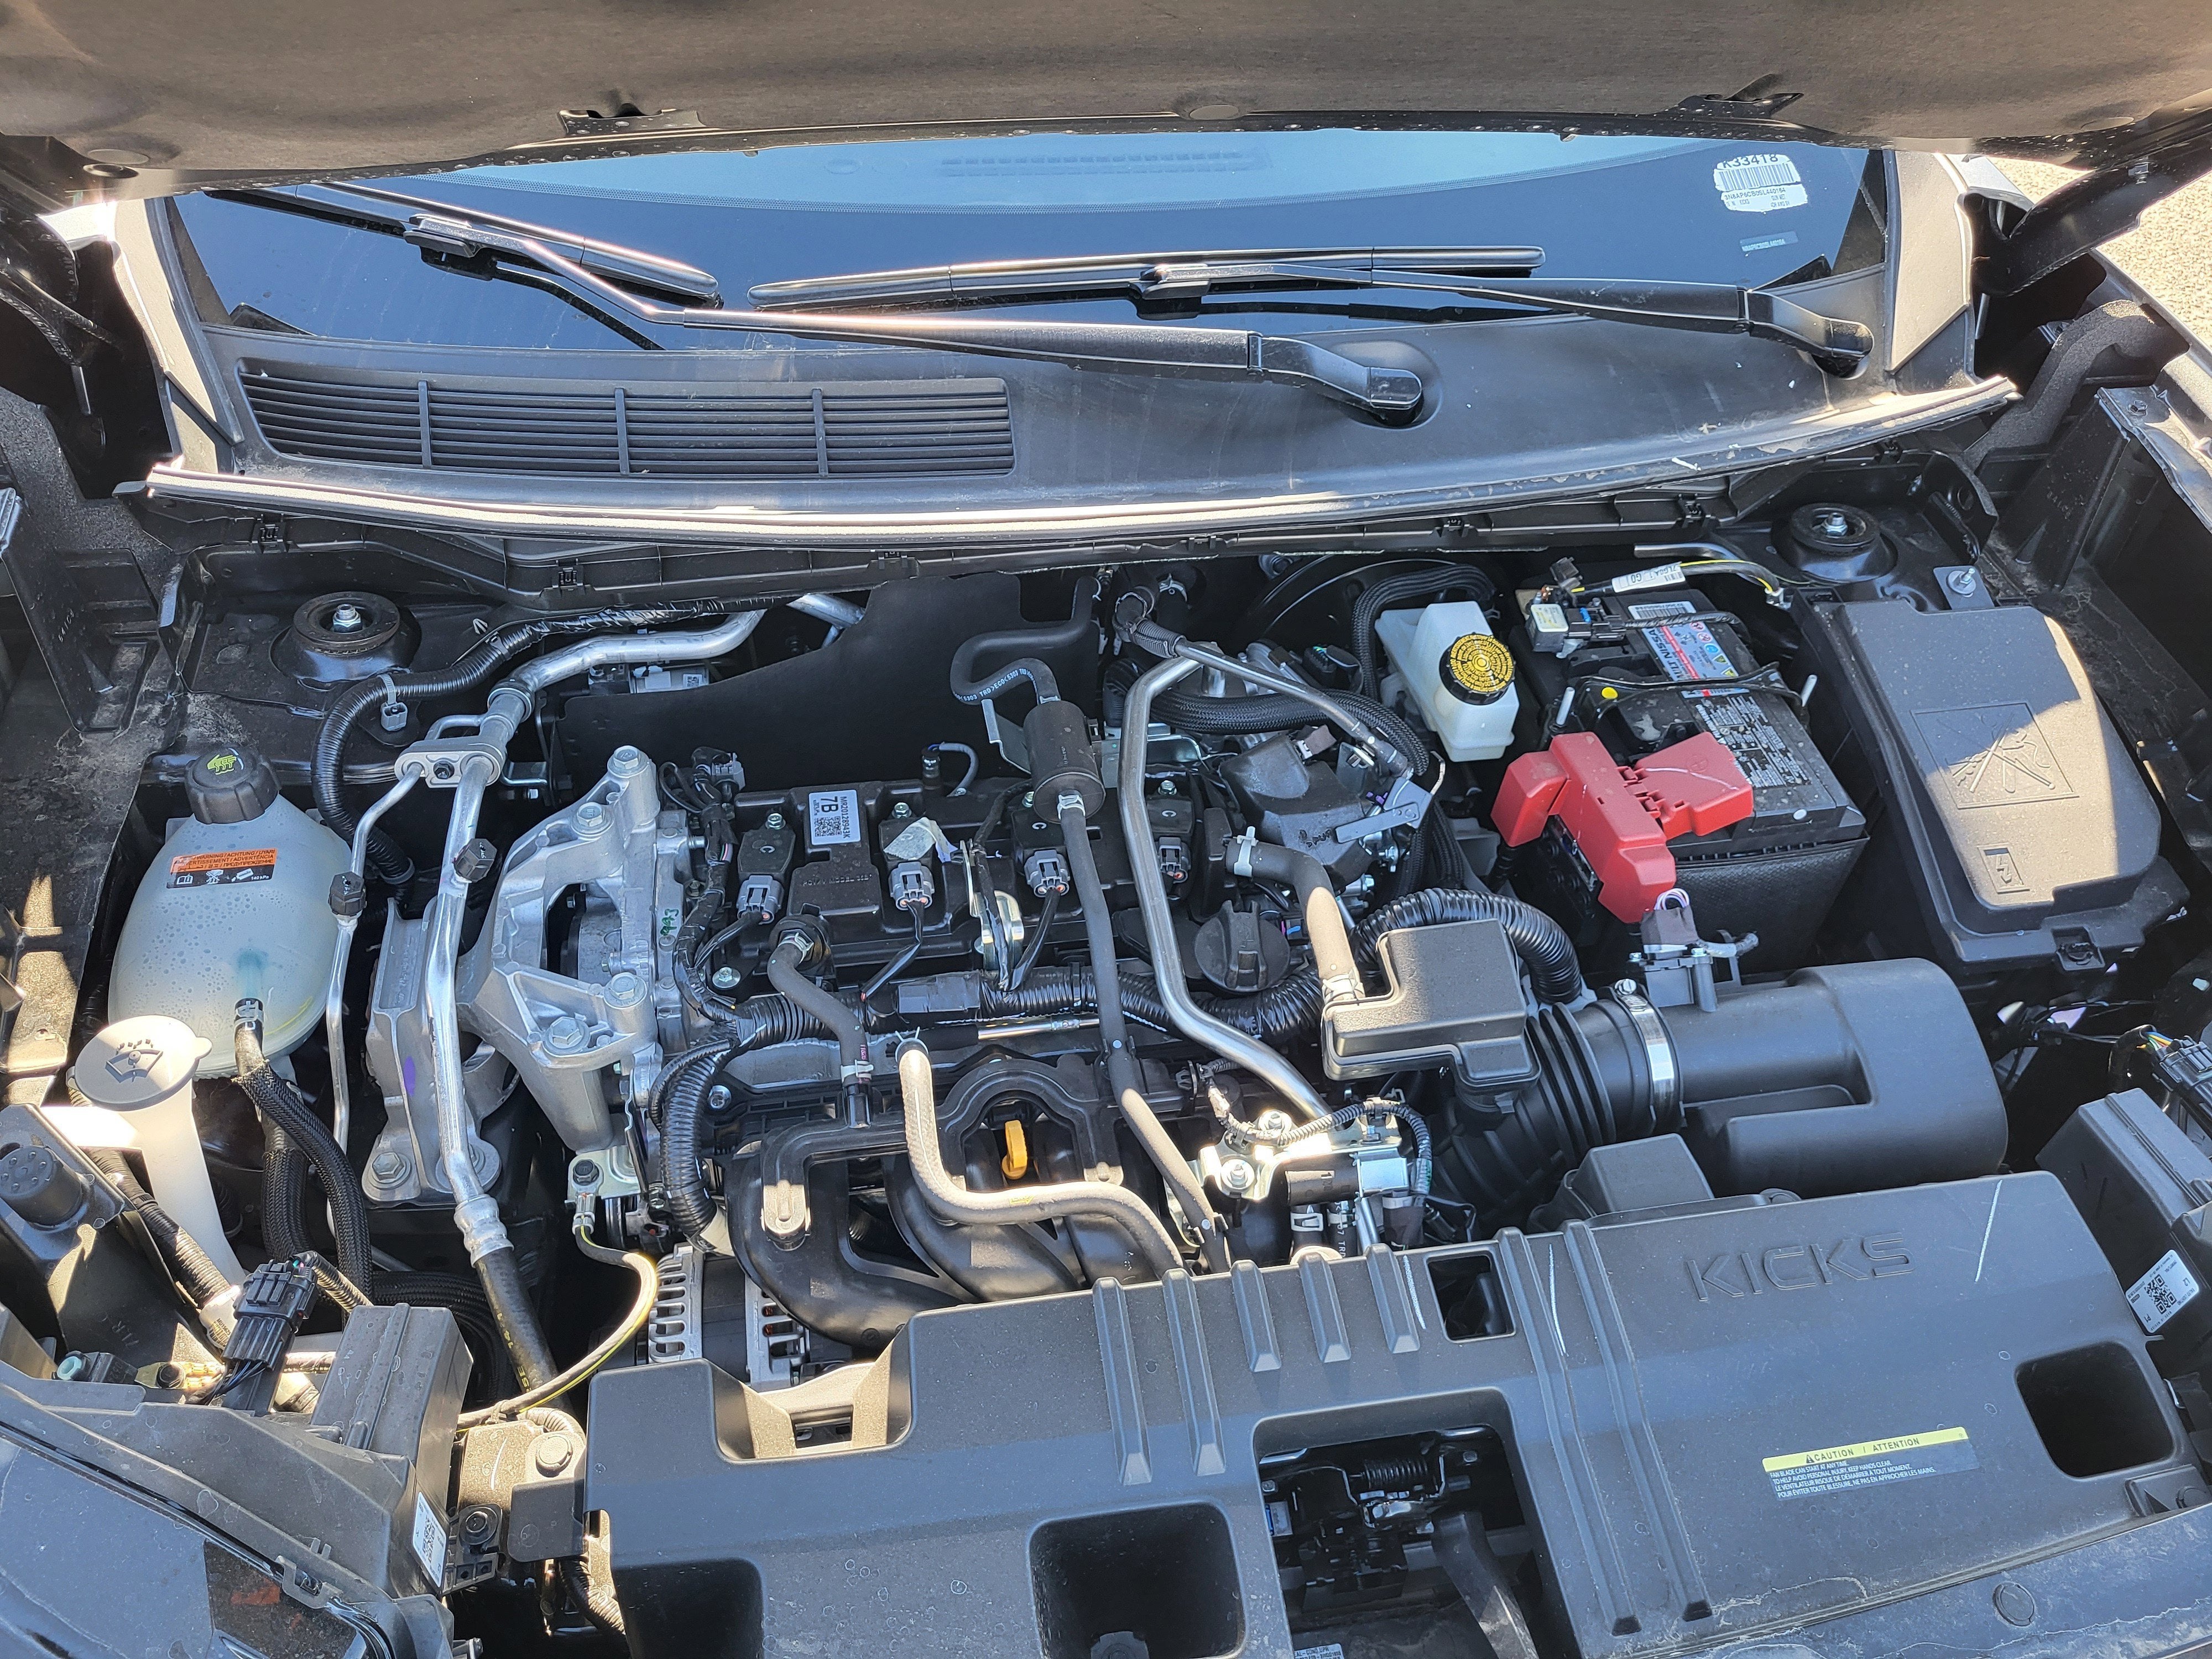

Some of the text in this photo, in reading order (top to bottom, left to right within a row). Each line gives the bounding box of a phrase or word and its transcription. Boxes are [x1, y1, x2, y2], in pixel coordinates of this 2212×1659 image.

[821, 796, 839, 813] 7B
[187, 857, 231, 865] ERTISSEMENT
[1684, 1232, 1917, 1302] KICKS
[1814, 1448, 1854, 1463] CAUTION
[1873, 1438, 1921, 1452] ATTENTION
[1807, 1471, 1832, 1480] PERSONAL
[1859, 1462, 1876, 1470] HANDS
[1781, 1479, 1815, 1490] VENTILATEUR
[1815, 1477, 1834, 1486] RISQUE
[1810, 1484, 1827, 1493] TOUTE
[1879, 1471, 1909, 1481] APPROCHER
